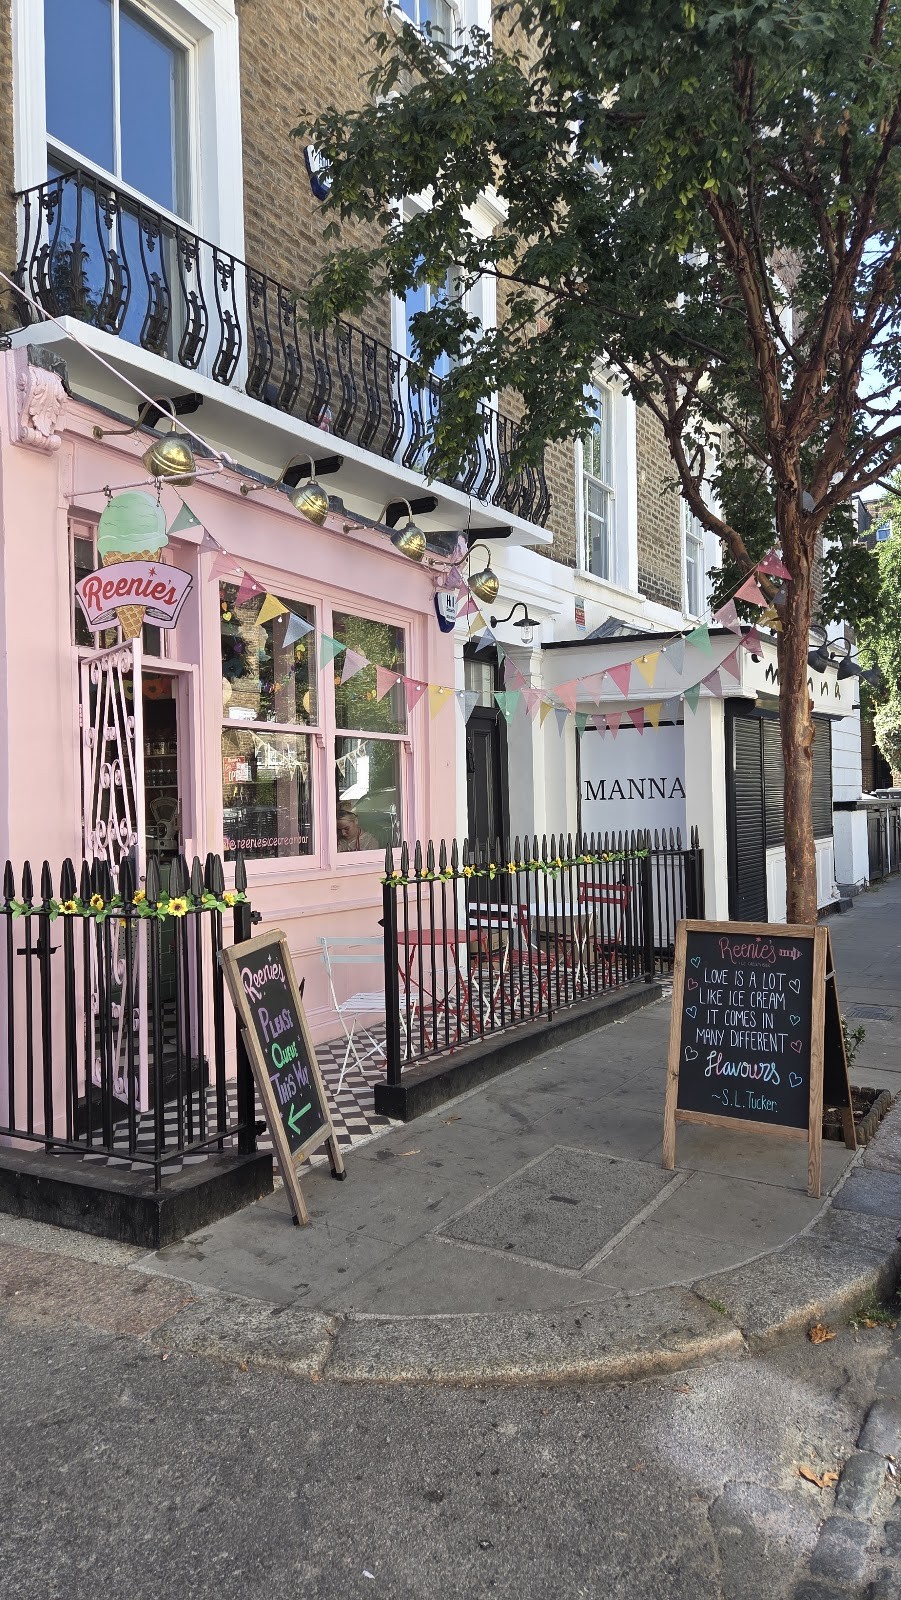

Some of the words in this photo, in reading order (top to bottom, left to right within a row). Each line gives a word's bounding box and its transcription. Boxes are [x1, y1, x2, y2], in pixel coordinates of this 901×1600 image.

[82, 569, 178, 611] Reenie's
[765, 663, 841, 700] mnna
[584, 777, 686, 801] MANNA
[719, 936, 777, 964] Reenie's
[704, 967, 729, 986] LOVE
[734, 970, 744, 987] IS
[748, 971, 757, 988] A
[762, 972, 787, 991] LOT
[699, 988, 723, 1006] LIKE
[728, 990, 745, 1007] ICE
[750, 991, 786, 1010] CREAM
[706, 1009, 719, 1025] IT
[724, 1010, 757, 1029] COMES
[762, 1012, 774, 1029] IN
[695, 1028, 725, 1046] MANY
[730, 1030, 789, 1053] DIFFERENT
